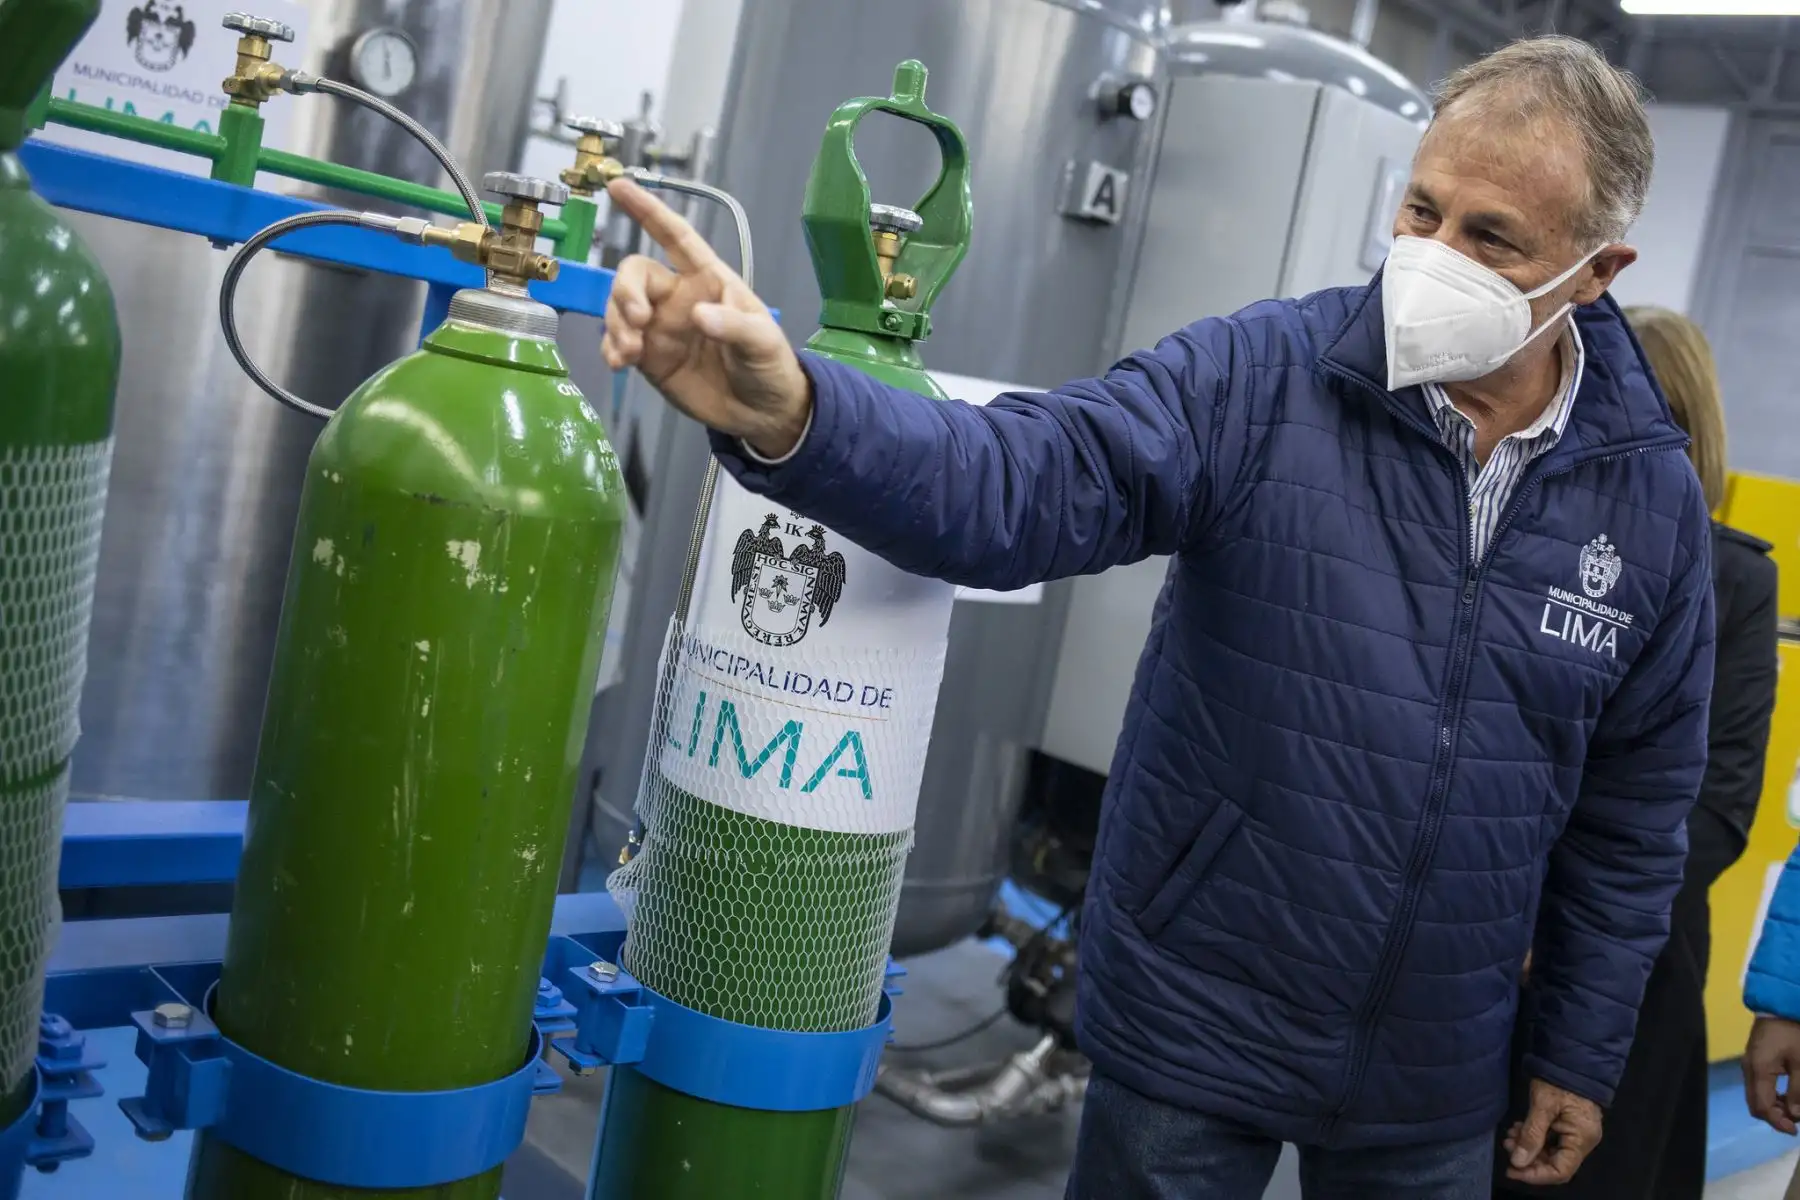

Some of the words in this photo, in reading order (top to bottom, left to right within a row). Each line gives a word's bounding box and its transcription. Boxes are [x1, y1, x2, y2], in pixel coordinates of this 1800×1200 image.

[73, 62, 204, 105] MUNICIPALIDAD
[1092, 173, 1116, 215] A
[784, 522, 804, 537] IK
[756, 554, 788, 569] HOC
[1548, 585, 1618, 618] MUNICIPALIDAD
[1618, 611, 1634, 624] DE
[1540, 603, 1617, 659] LIMA
[860, 685, 893, 708] DE
